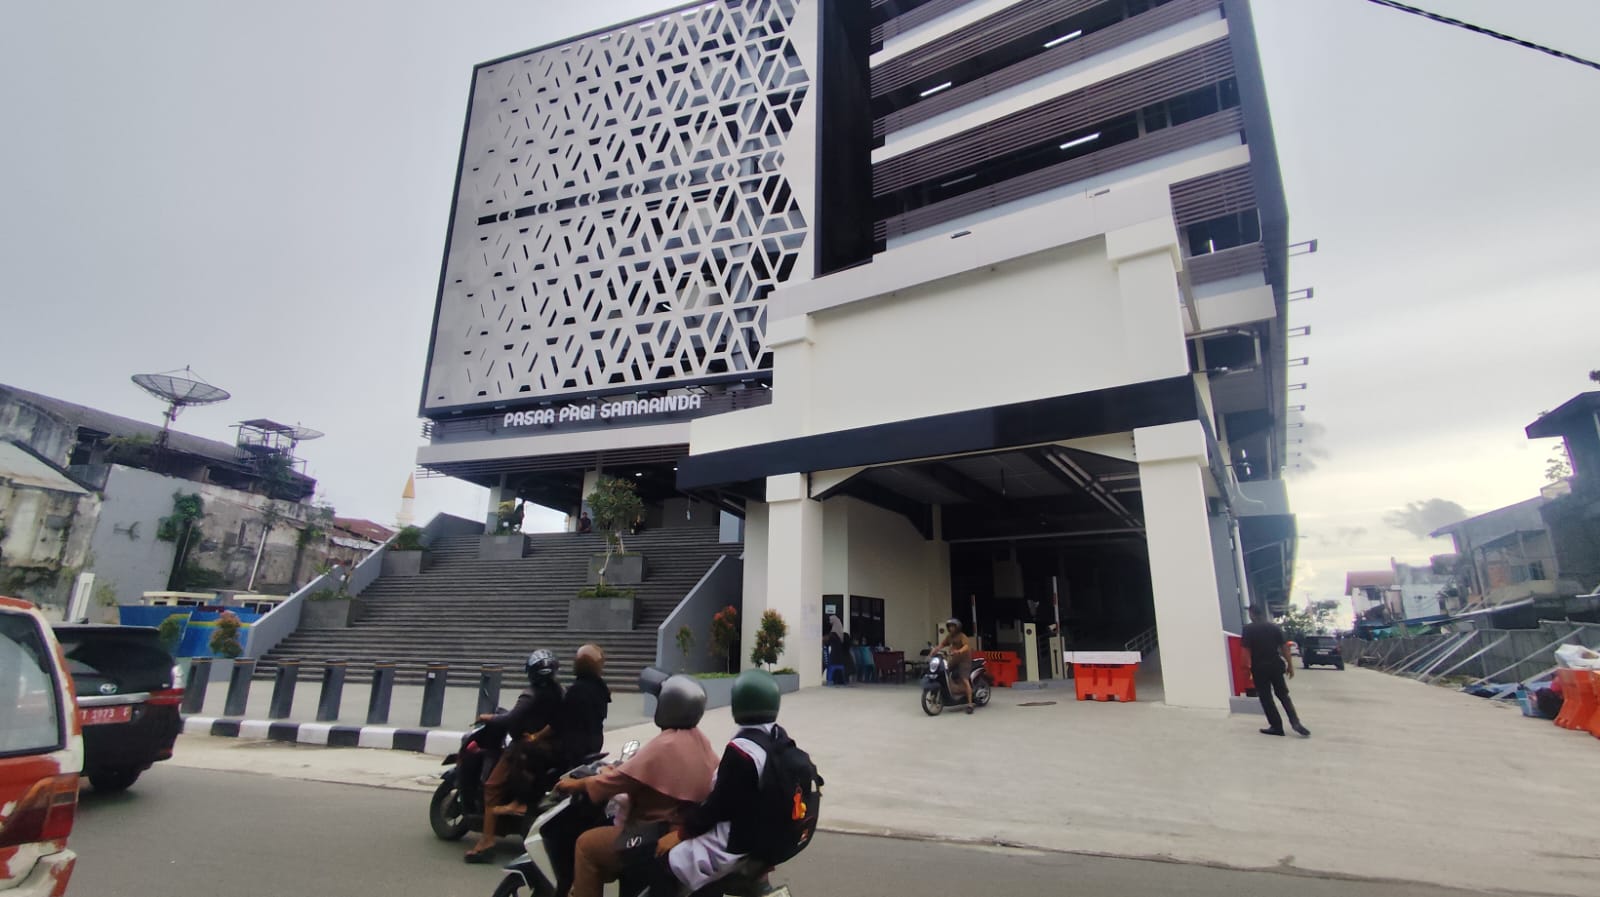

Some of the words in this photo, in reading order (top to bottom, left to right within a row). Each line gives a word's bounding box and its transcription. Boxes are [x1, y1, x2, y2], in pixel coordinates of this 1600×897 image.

[503, 408, 555, 427] PASAR
[559, 404, 595, 422] PAGI
[600, 394, 701, 418] SAMARINDA
